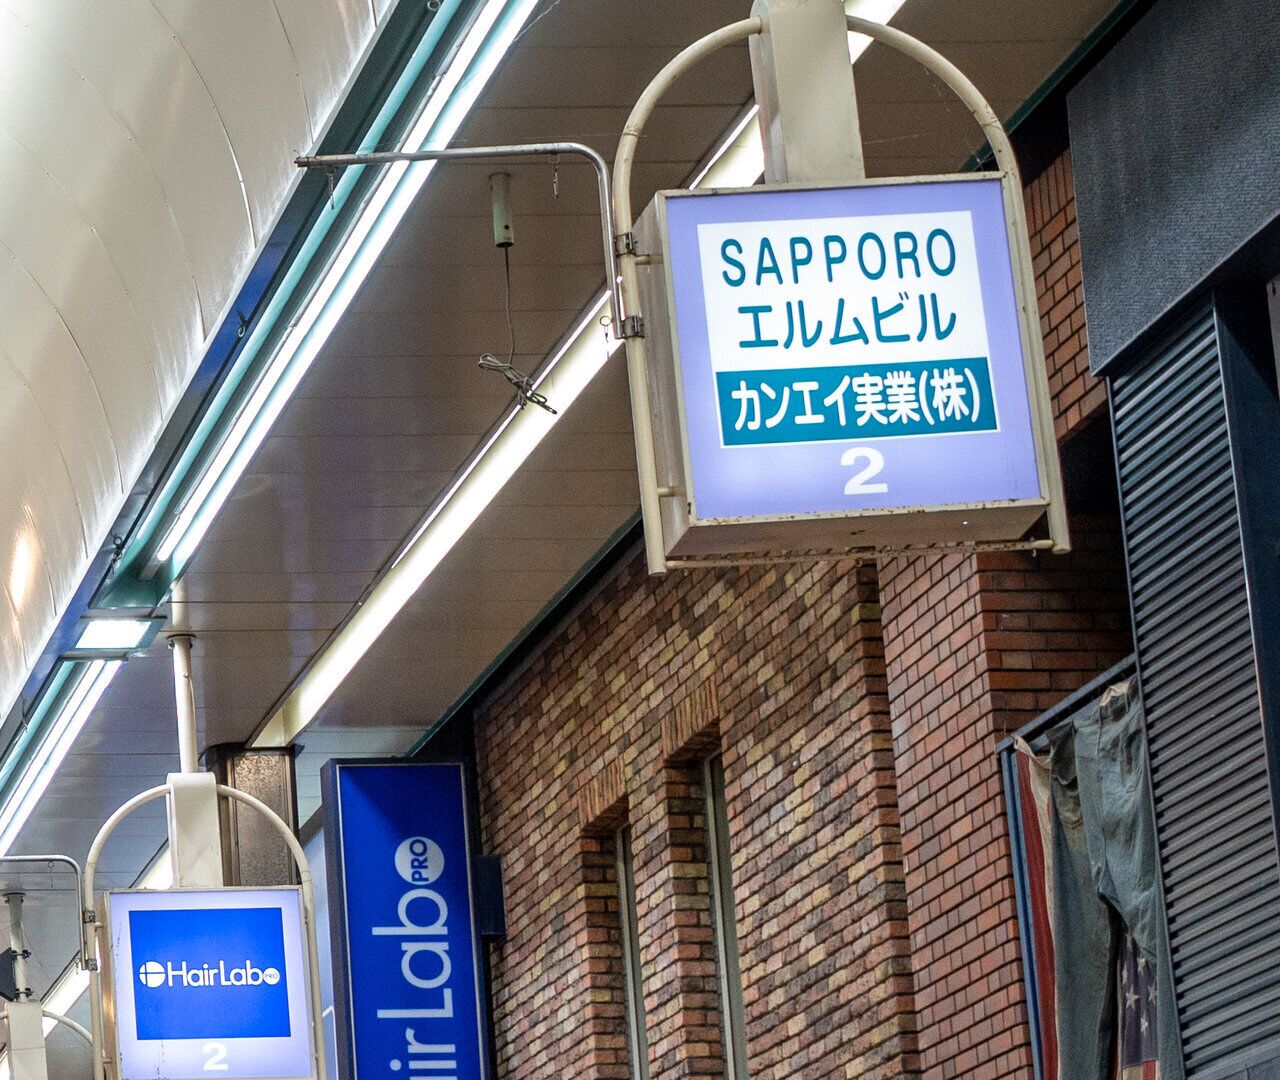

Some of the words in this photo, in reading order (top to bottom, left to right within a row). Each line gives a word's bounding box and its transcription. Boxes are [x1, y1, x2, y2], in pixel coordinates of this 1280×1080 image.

[720, 228, 956, 288] SAPPORO
[738, 292, 957, 349] エルムビル
[731, 368, 980, 431] カンエイ実業(株)
[840, 447, 888, 495] 2
[410, 837, 428, 882] PRO
[203, 1043, 229, 1070] 2
